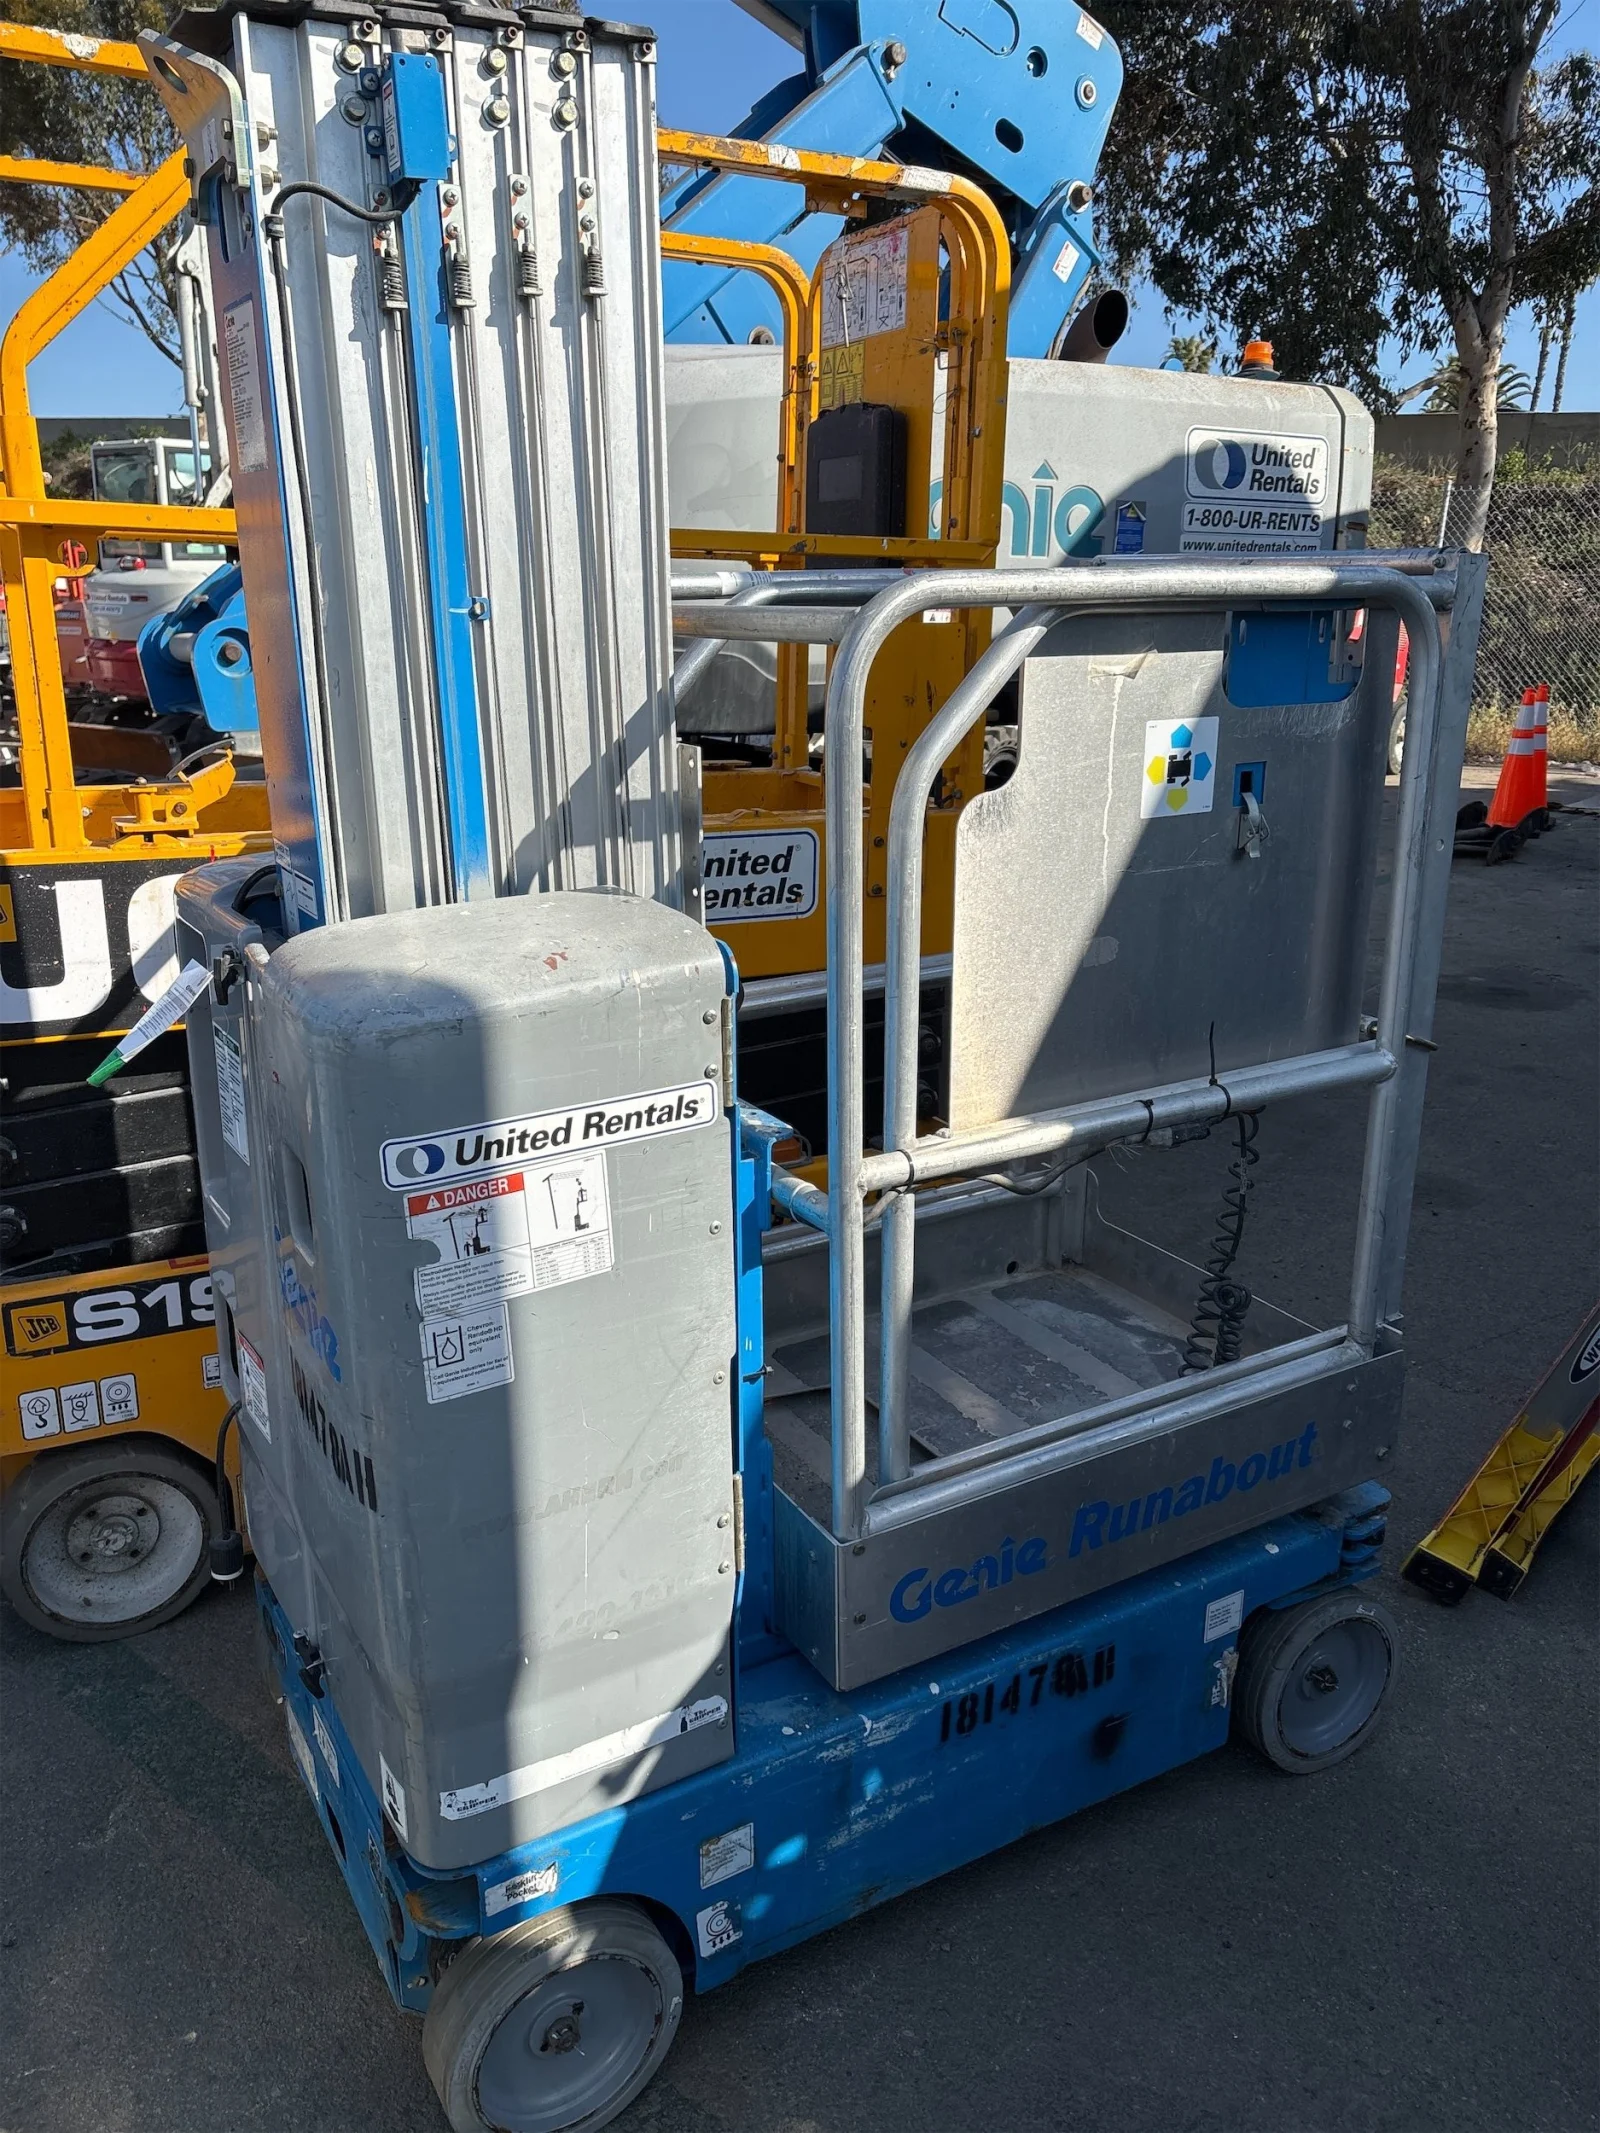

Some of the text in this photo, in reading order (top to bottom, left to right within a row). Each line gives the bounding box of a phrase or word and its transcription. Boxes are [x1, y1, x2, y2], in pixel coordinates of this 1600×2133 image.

[1251, 443, 1317, 469] United
[1249, 468, 1320, 495] Rentals
[1187, 508, 1321, 532] 1-800-UR-RENTS
[1183, 539, 1318, 553] www.unitedrentals.com
[703, 845, 794, 878] nited
[705, 877, 804, 910] entals
[455, 1094, 699, 1167] United Rentals
[443, 1177, 510, 1207] DANGER
[27, 1316, 57, 1339] JCB
[467, 1321, 494, 1332] Chevron
[493, 1325, 504, 1333] HD
[468, 1333, 501, 1347] equivalent
[469, 1346, 483, 1354] only
[436, 1375, 465, 1385] equivalent
[475, 1366, 495, 1375] optional
[444, 1370, 459, 1378] Genie
[460, 1363, 486, 1373] Industries
[889, 1421, 1318, 1624] Genie Runabout
